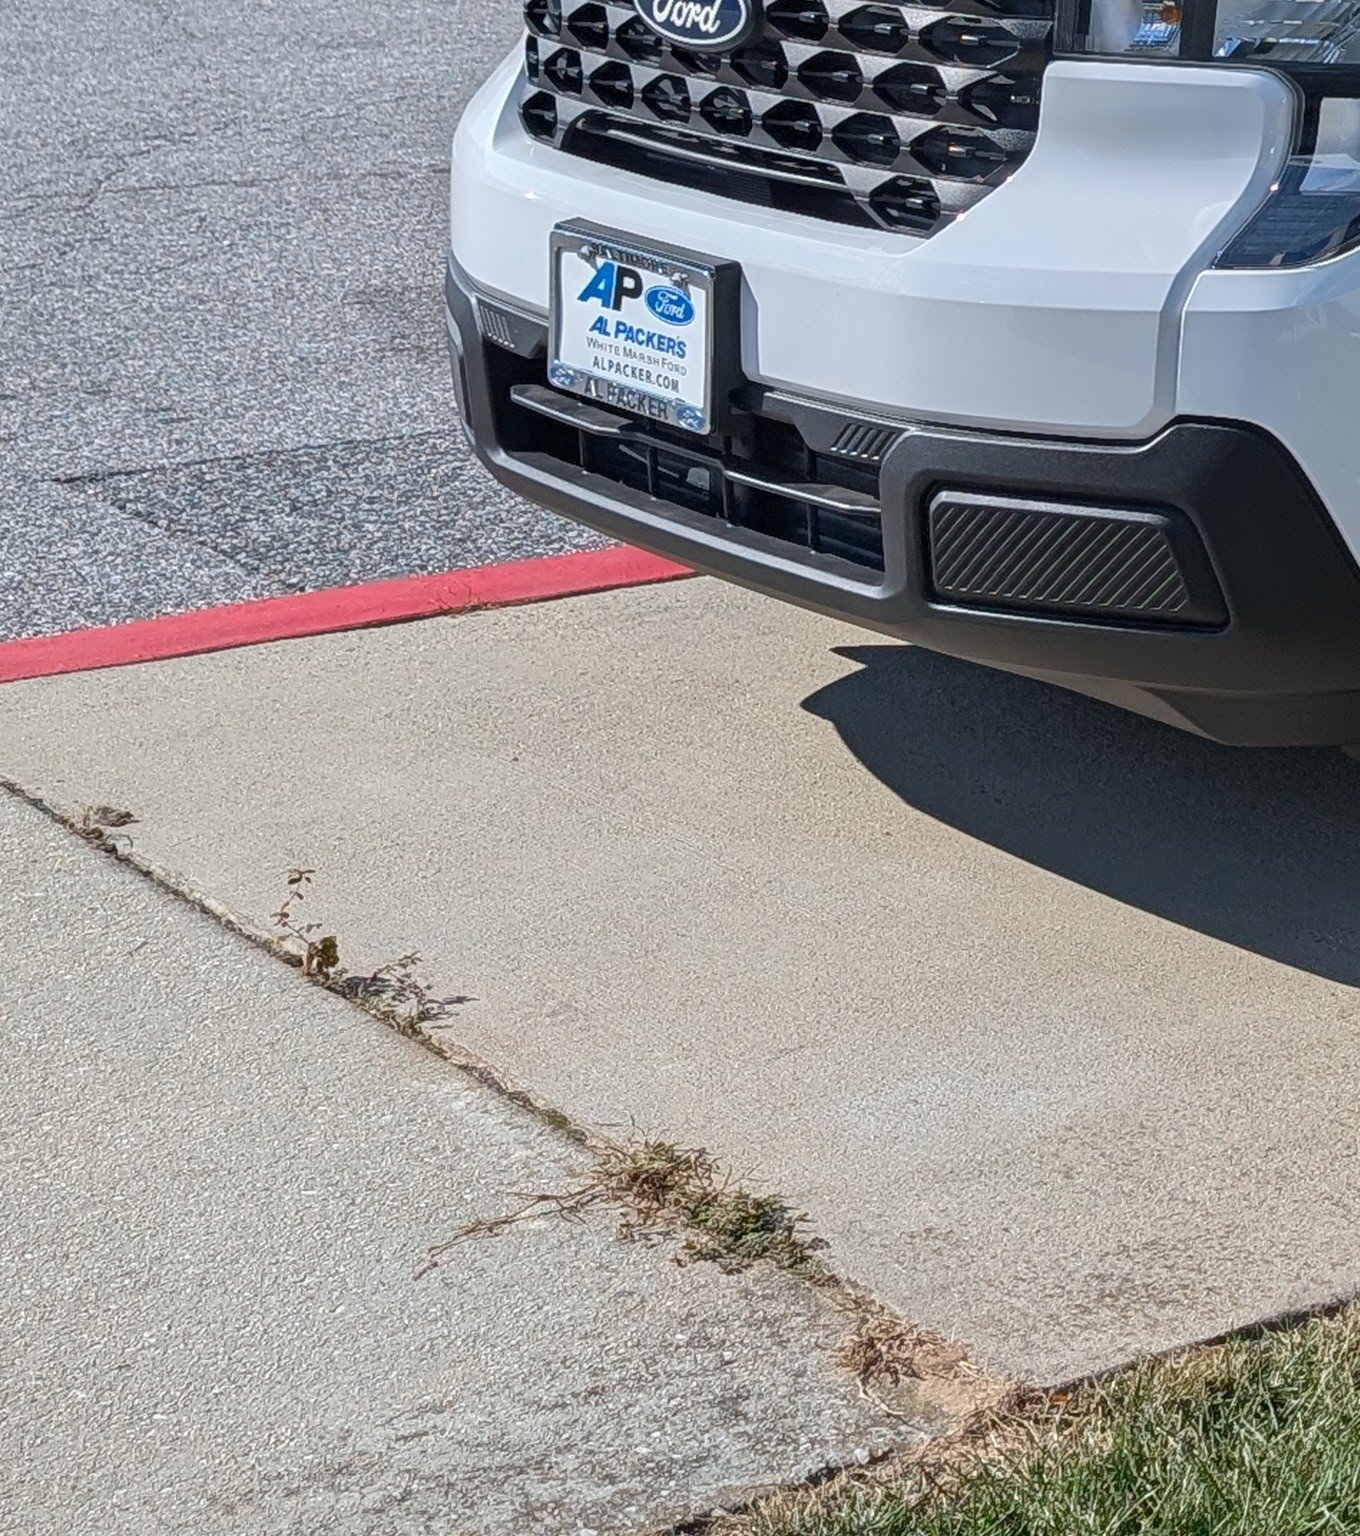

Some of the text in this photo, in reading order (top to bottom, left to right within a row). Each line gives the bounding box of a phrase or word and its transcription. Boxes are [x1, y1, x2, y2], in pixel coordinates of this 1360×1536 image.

[577, 261, 644, 312] AP
[589, 315, 687, 359] AL PACKER'S
[592, 355, 680, 393] ALPACKER.COM
[607, 382, 669, 421] PACKER
